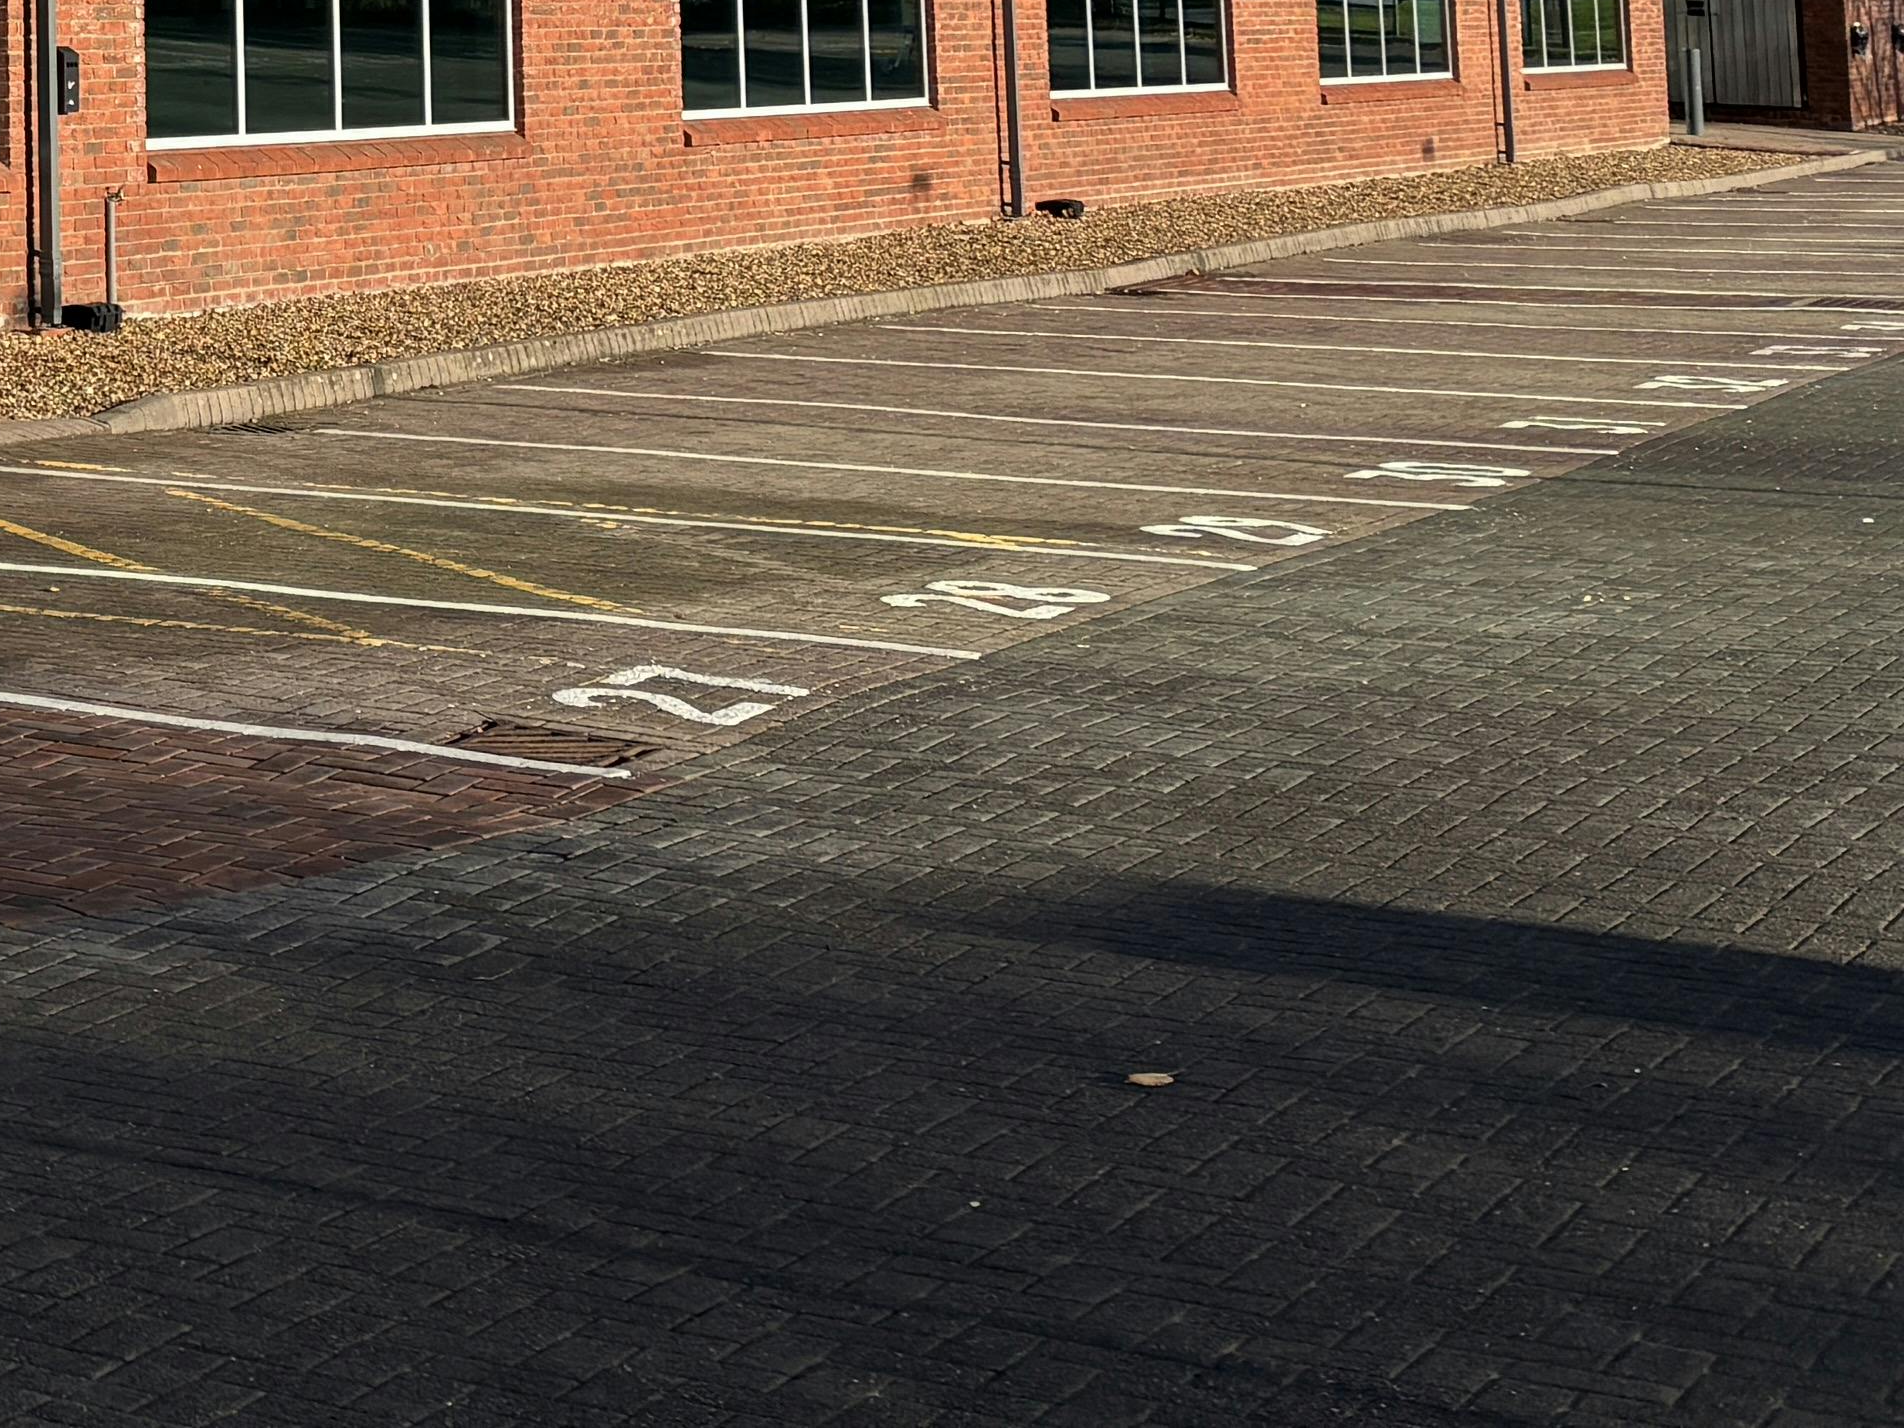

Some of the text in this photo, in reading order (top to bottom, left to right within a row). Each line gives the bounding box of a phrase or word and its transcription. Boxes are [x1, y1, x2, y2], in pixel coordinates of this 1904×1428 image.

[1632, 374, 1790, 393] 32
[1497, 416, 1667, 435] 31
[1343, 461, 1532, 487] 30
[1139, 515, 1340, 546] 29
[879, 580, 1111, 620] 28
[551, 664, 811, 726] 27
